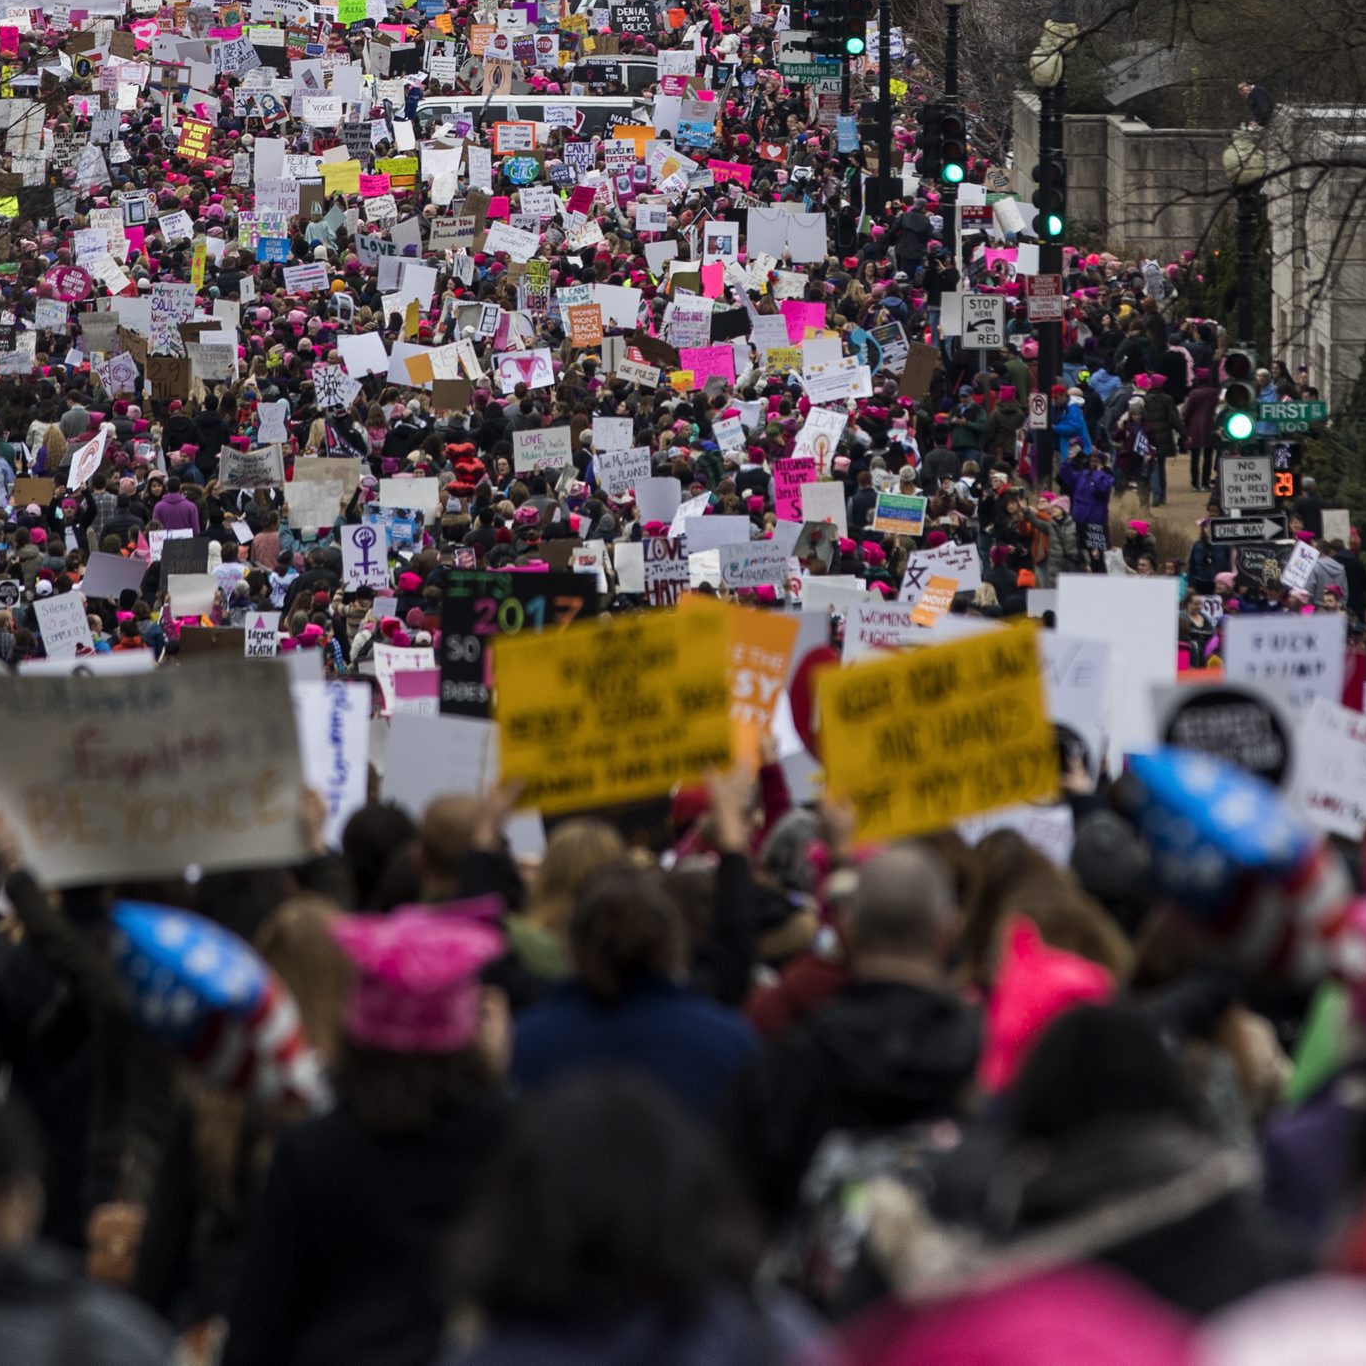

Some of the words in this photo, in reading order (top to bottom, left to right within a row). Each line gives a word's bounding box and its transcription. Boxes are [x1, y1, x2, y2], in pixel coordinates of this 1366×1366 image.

[617, 7, 648, 17] DENIAL
[622, 23, 651, 32] POLICY
[659, 64, 695, 75] TRUMP
[783, 65, 827, 76] Washington
[822, 81, 841, 91] ALT
[183, 122, 192, 130] WE
[189, 131, 203, 140] PICK
[184, 139, 205, 148] TRUMP
[566, 143, 593, 154] CAN'T
[605, 147, 625, 155] RESPECT
[565, 154, 596, 164] TOUCH
[605, 155, 636, 163] EXISTENCE
[281, 183, 297, 193] LOW
[278, 198, 298, 210] HIGH
[240, 212, 260, 221] YOU
[435, 220, 456, 228] Thank
[433, 231, 458, 239] President
[360, 237, 396, 254] LOVE
[568, 286, 590, 295] CAN'T
[151, 298, 177, 312] SOUL
[969, 299, 998, 310] STOP
[573, 316, 599, 324] WON'T
[575, 332, 601, 340] DOWN
[978, 334, 1000, 345] RED
[620, 365, 632, 373] ONE
[634, 369, 658, 382] PULSE
[1262, 404, 1308, 419] FIRST
[1278, 422, 1309, 432] 100
[520, 434, 544, 446] LOVE
[534, 442, 546, 450] not
[549, 440, 565, 448] hate
[522, 450, 542, 460] Makes
[543, 448, 567, 457] America
[536, 457, 564, 467] GREAT
[1238, 462, 1256, 470] NO
[618, 467, 649, 479] PLANNED
[783, 472, 808, 484] TRUMP
[1233, 473, 1262, 482] TURN
[1227, 485, 1242, 493] ON
[1248, 484, 1268, 493] RED
[1216, 524, 1241, 537] ONE
[1242, 524, 1265, 537] WAY
[642, 537, 689, 562] LOVE
[348, 569, 362, 582] Up
[371, 567, 385, 578] The
[644, 579, 690, 606] HATE
[41, 602, 77, 617] Silence
[473, 594, 585, 635] 2017
[859, 629, 902, 645] RIGHTS
[445, 635, 481, 662] SO
[1250, 634, 1318, 652] FUCK
[248, 643, 274, 655] DEATH
[443, 680, 489, 702] DOES
